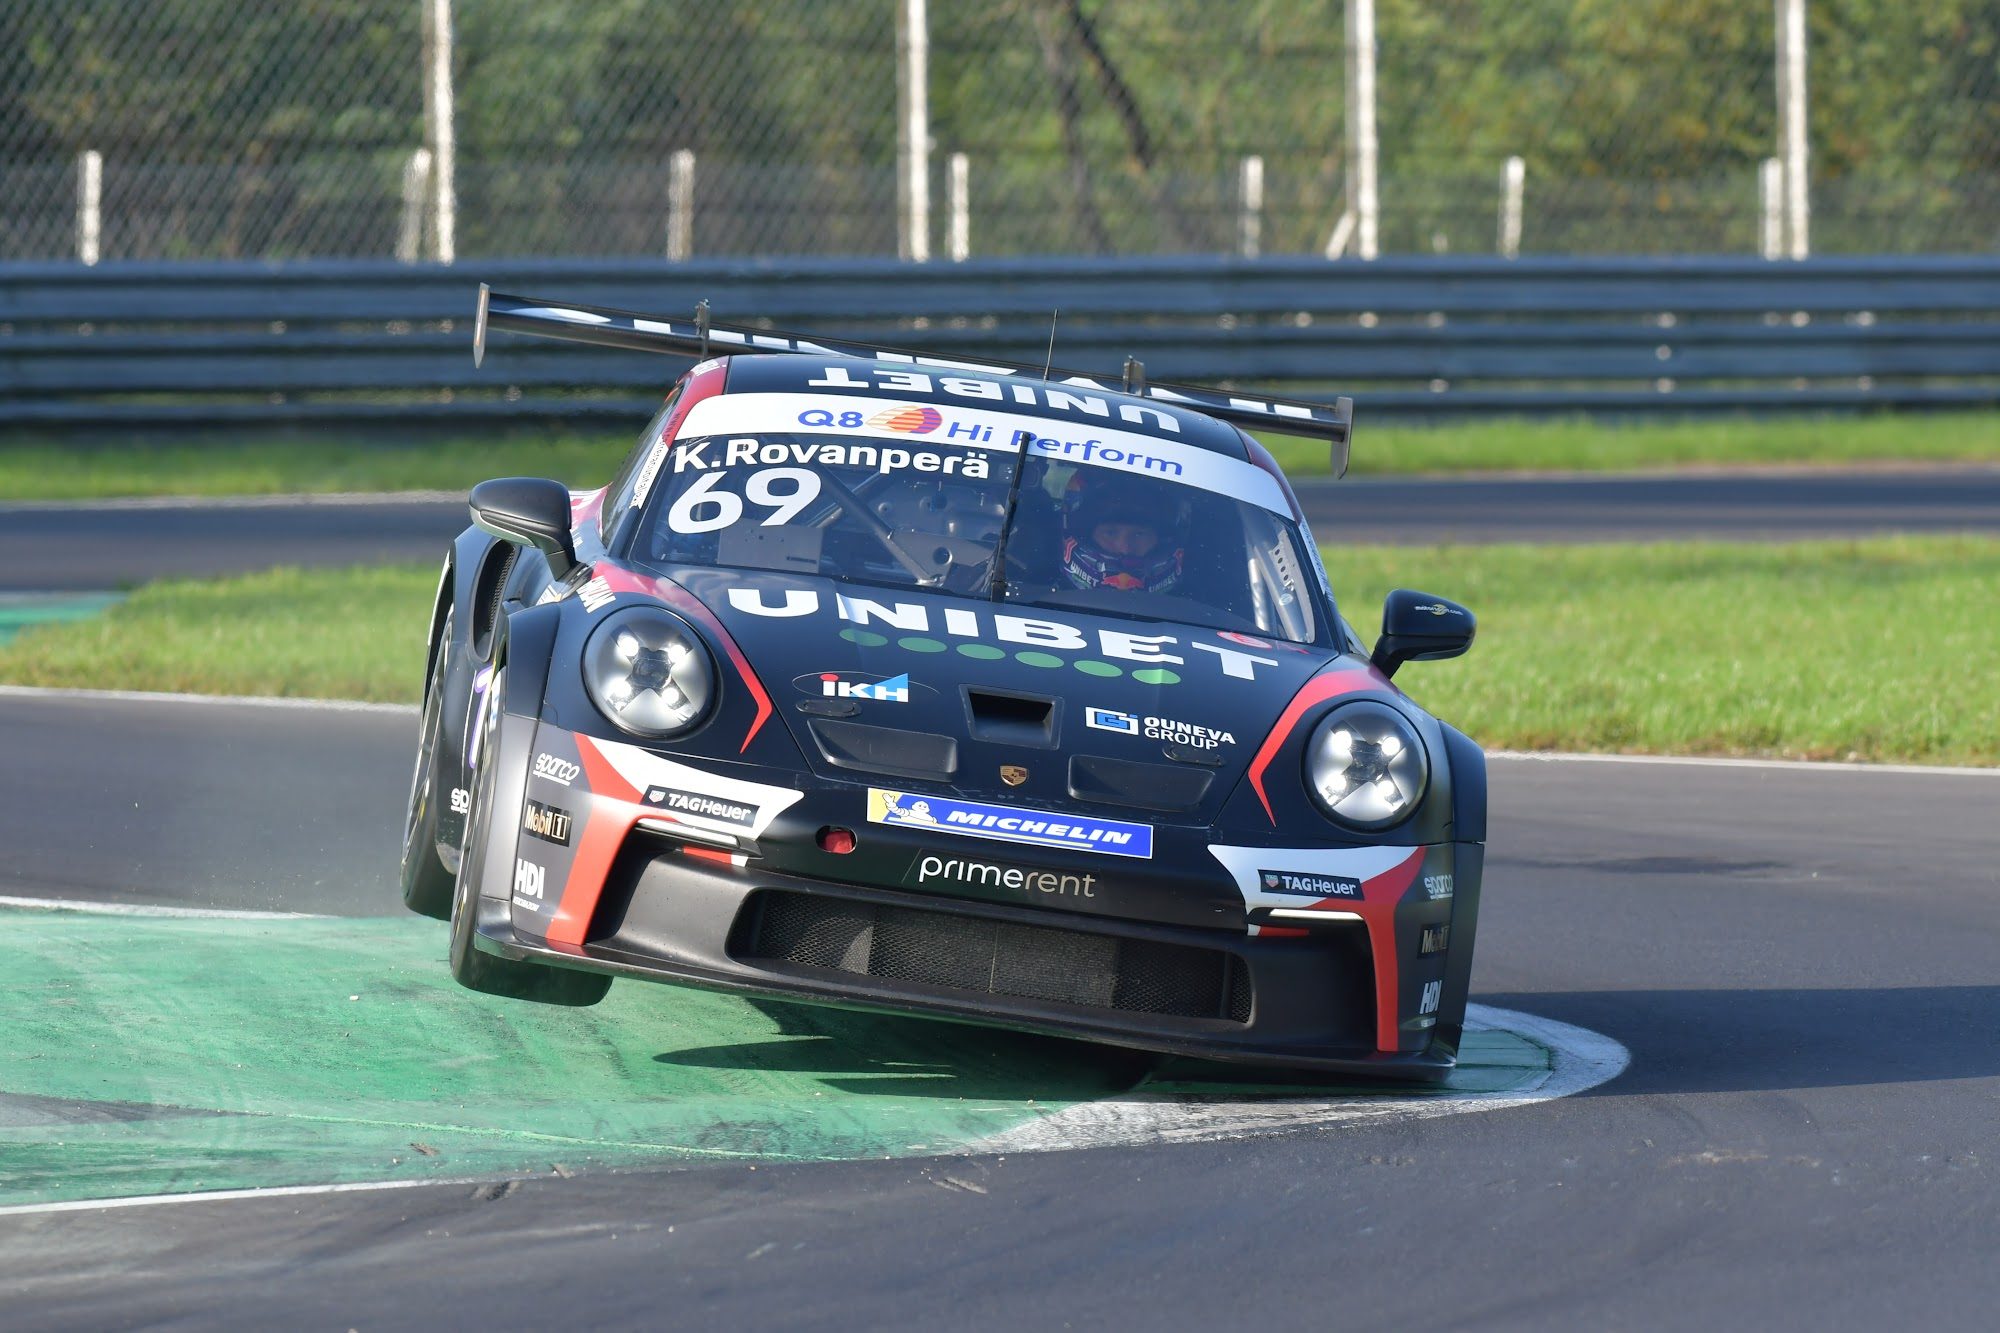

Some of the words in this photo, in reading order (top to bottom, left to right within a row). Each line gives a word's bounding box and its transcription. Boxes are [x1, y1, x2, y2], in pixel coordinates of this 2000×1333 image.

[807, 366, 1181, 433] UNIBET
[673, 438, 989, 480] K.Rovanperä
[797, 409, 864, 428] Q8
[947, 421, 992, 442] Hi
[1010, 429, 1183, 476] Perform
[667, 468, 821, 535] 69
[1070, 561, 1100, 587] UNIBET
[728, 587, 1279, 682] UNIBET
[1143, 716, 1237, 745] OUNEVA
[1143, 727, 1219, 751] GROUP
[535, 752, 581, 783] sparco
[524, 805, 553, 836] Mobil
[946, 809, 1133, 845] MICHELIN
[514, 858, 545, 900] HDI
[918, 855, 1096, 898] primerent
[1424, 873, 1453, 897] sparco
[1420, 980, 1442, 1014] HDI
